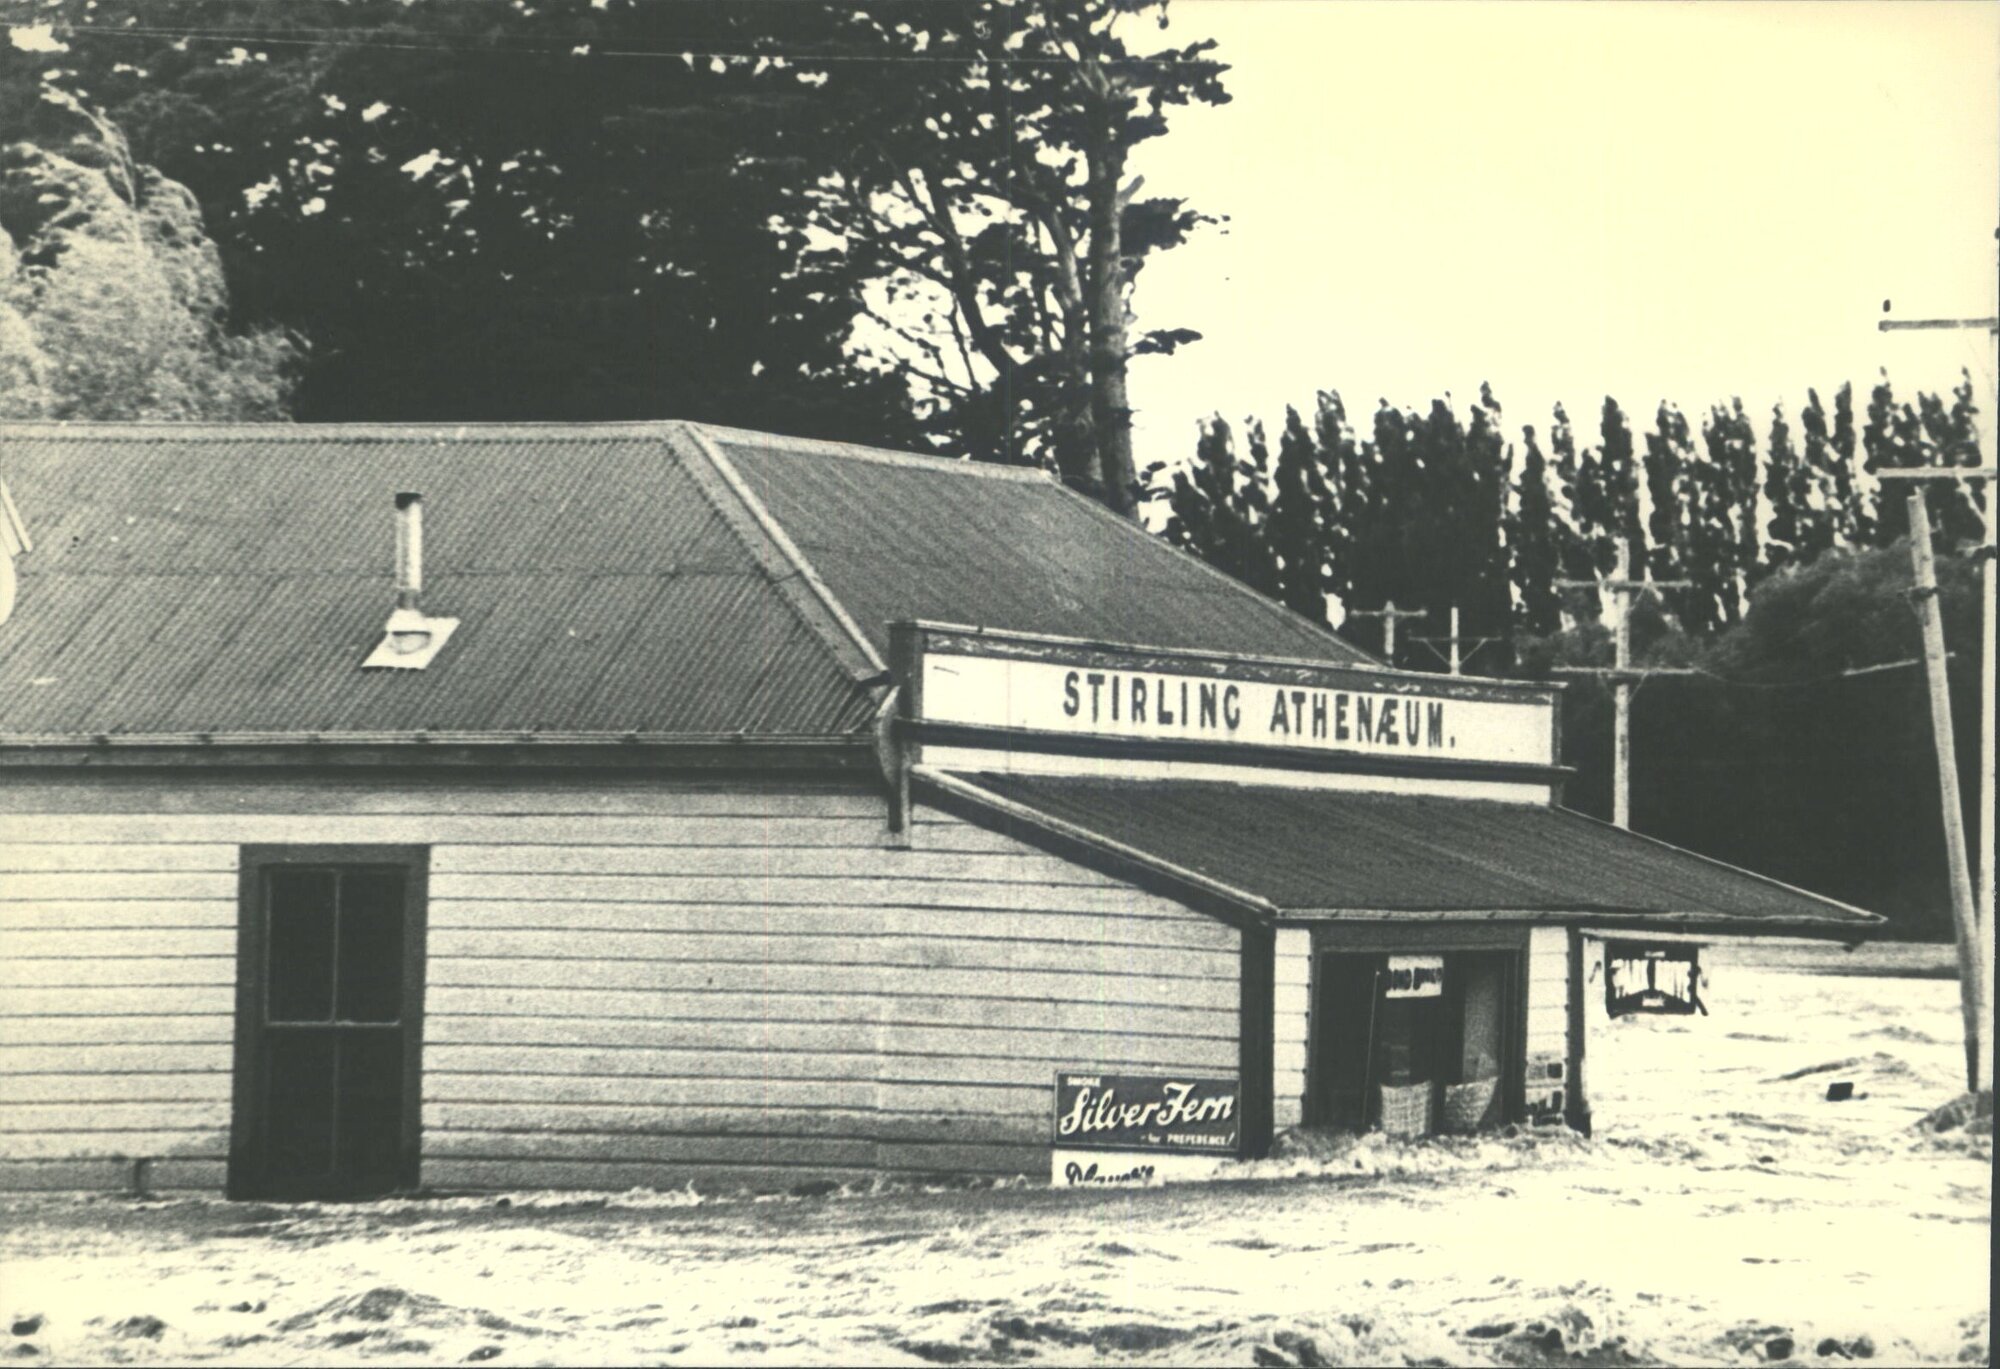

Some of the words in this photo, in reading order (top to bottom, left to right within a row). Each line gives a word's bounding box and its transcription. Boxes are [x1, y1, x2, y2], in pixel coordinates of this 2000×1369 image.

[1062, 671, 1241, 730] STIRLING
[1059, 1087, 1161, 1135] Silver
[1156, 1081, 1235, 1127] Fern
